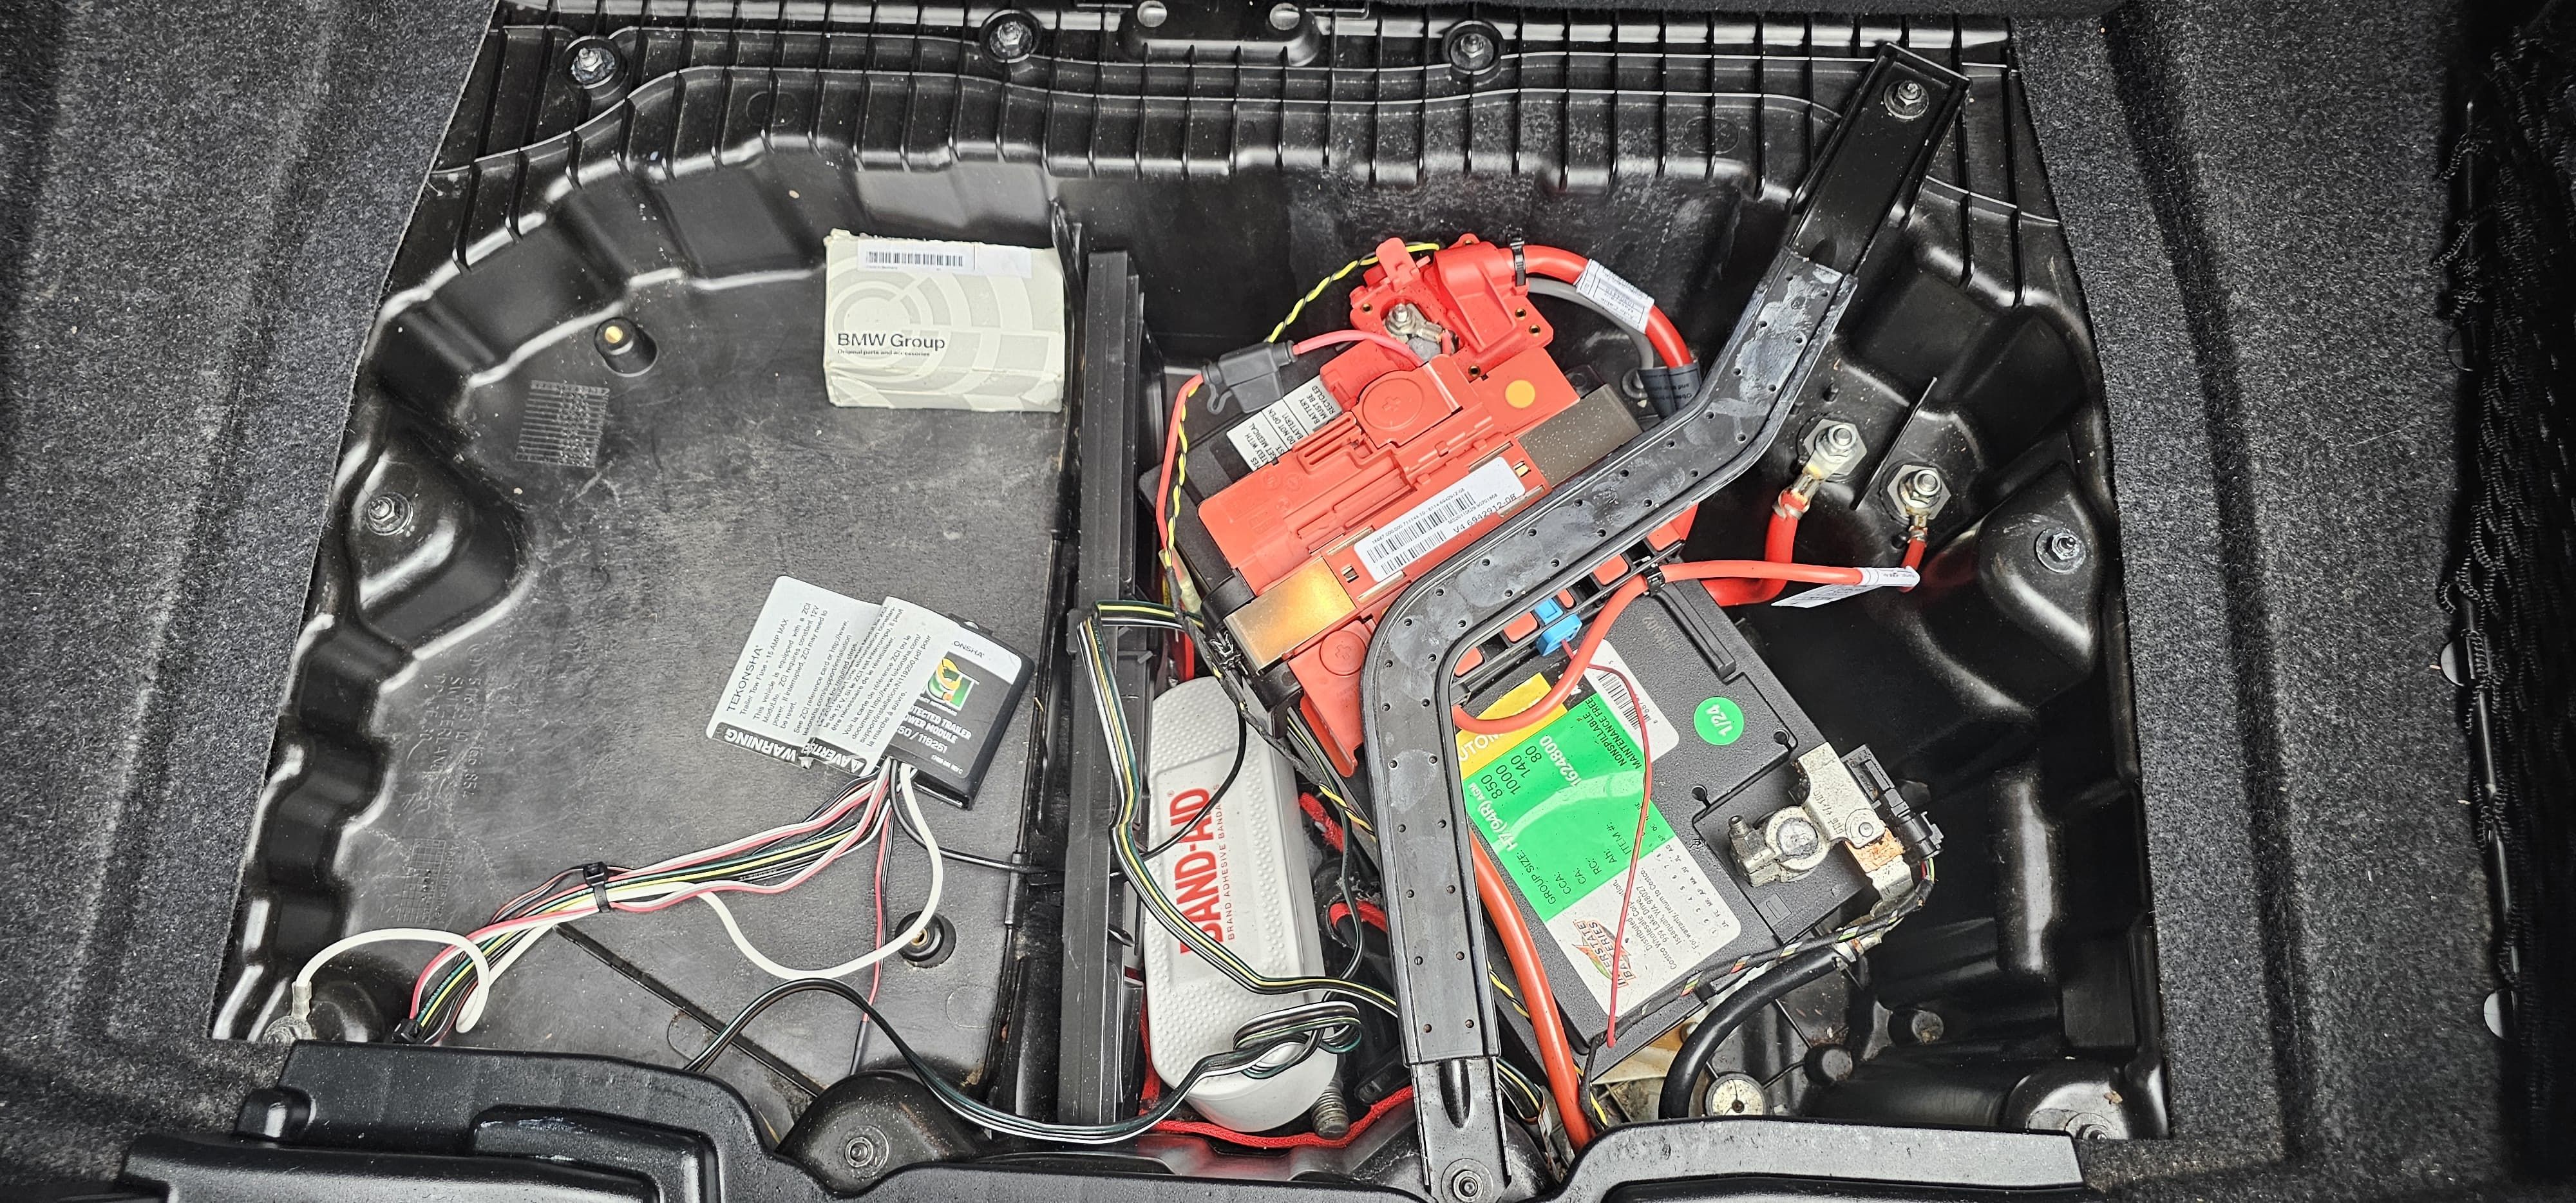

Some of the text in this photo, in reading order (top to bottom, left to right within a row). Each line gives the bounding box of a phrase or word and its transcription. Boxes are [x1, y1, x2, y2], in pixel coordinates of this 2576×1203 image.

[837, 334, 945, 350] BMW Group
[1298, 397, 1320, 424] BATTERY
[1306, 393, 1327, 419] MUST BE
[1311, 384, 1335, 415] RECYCLED
[1244, 432, 1258, 449] WITH
[1247, 422, 1277, 459] GET MEDICAL
[1267, 408, 1296, 444] DO NOT OPEN
[1452, 493, 1517, 534] V4 6942912-08
[777, 674, 788, 687] ZCI
[785, 647, 801, 674] requires
[797, 618, 813, 647] constant
[810, 605, 820, 618] 12V
[829, 680, 849, 705] requiert
[846, 668, 857, 680] une
[853, 631, 880, 668] alimentation
[876, 605, 897, 632] constan-
[846, 640, 858, 661] steps.
[869, 634, 896, 669] réinitialiser.
[920, 634, 932, 649] pour
[727, 645, 762, 712] TEKONSHA
[739, 618, 788, 715] Trailer Tow Fuse 15 AMP MAX
[752, 705, 764, 721] This
[760, 679, 775, 704] vehicle
[776, 639, 795, 670] equipped
[791, 623, 801, 638] with
[800, 602, 811, 615] ZCI
[771, 609, 828, 726] power. interrupted, ZCI may need to
[827, 712, 836, 721] de
[833, 701, 843, 712] 12
[839, 695, 848, 704] V.
[844, 688, 851, 696] Si
[853, 670, 864, 683] ZCI
[860, 659, 871, 670] est
[866, 625, 894, 661] interrompu,
[891, 607, 905, 623] peut
[860, 675, 869, 685] de
[866, 668, 874, 676] le
[792, 719, 804, 734] See
[799, 705, 809, 719] ZCI
[805, 675, 823, 706] reference
[819, 660, 830, 676] card
[838, 683, 864, 718] nécessaire
[842, 633, 912, 737] Voir la carte de référence ZCI ou le
[779, 699, 797, 729] be reset.
[829, 717, 842, 731] être
[851, 708, 874, 740] document
[866, 739, 875, 747] la
[871, 715, 890, 740] marche
[891, 688, 907, 711] suivre.
[1584, 696, 1603, 717] FREE
[1704, 701, 1735, 739] 1/24
[723, 726, 799, 762] WARNING
[924, 723, 958, 743] MODULE
[940, 718, 972, 740] TRAILER
[1582, 711, 1627, 766] NONSPILLABLE
[1598, 715, 1642, 769] MAINTENANCE
[1213, 784, 1225, 838] BANDAS
[1509, 753, 1602, 875] RC: 140
[1524, 744, 1617, 866] Ah: 80
[1539, 733, 1633, 856] ITEM #: 1624800
[1467, 781, 1557, 906] GROUP SIZE: H7 (94R) AGM
[1479, 772, 1572, 896] CCA: 850
[1494, 763, 1588, 885] CA: 1000
[1665, 844, 1673, 853] AG
[1219, 844, 1230, 896] ADHESIVE
[1681, 866, 1689, 874] JU
[1689, 876, 1698, 886] MA
[1611, 878, 1678, 970] Costco Wholesale Corption,
[1633, 896, 1669, 943] 999 Lake Drive,
[1636, 884, 1683, 945] Issaquah, WA 98027
[1637, 867, 1699, 949] For warranty, return to Costco.
[1625, 916, 1653, 951] Distributed
